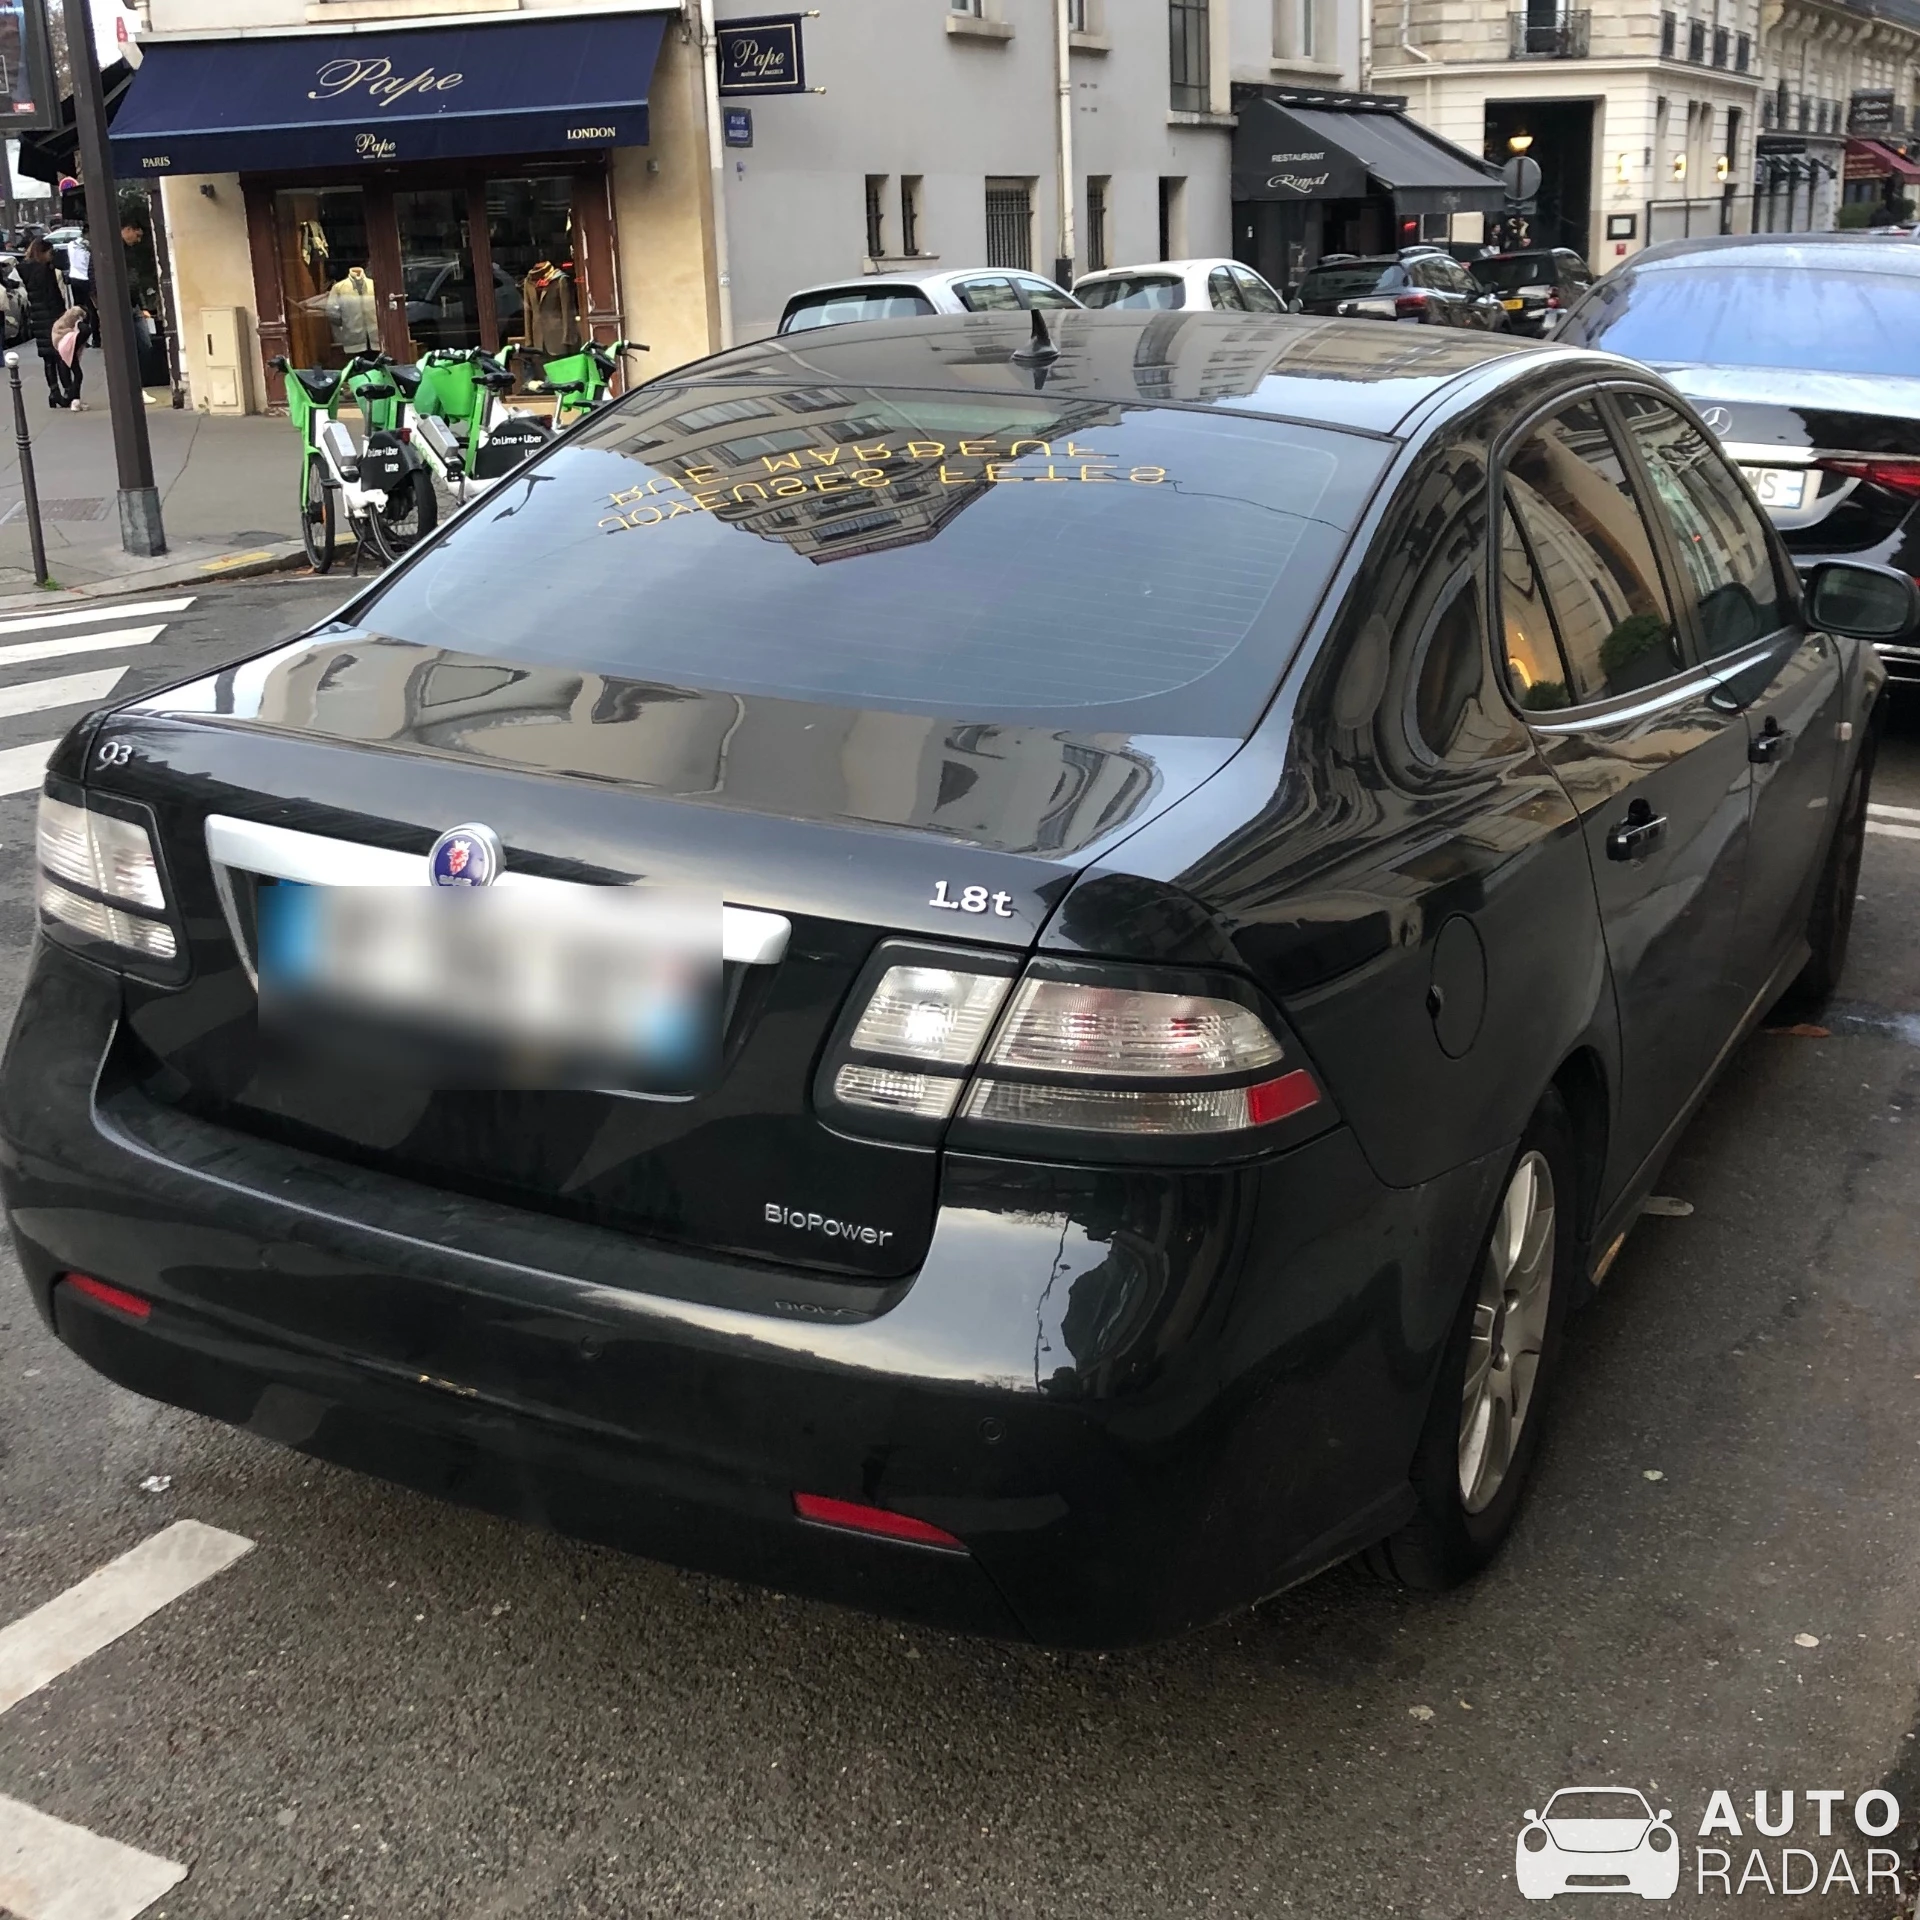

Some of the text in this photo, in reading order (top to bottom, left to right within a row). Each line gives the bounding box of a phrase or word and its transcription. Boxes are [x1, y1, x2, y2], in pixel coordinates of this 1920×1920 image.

[731, 39, 785, 76] Pape
[308, 56, 464, 107] Pape
[566, 126, 616, 140] LONDON
[355, 133, 397, 158] Pape
[142, 155, 171, 168] PARIS
[1271, 151, 1325, 163] RESTAURANT
[491, 436, 501, 446] On
[501, 435, 518, 445] Lime
[523, 434, 543, 444] Uber
[385, 446, 399, 456] Uber
[384, 463, 399, 472] Lime
[928, 880, 1012, 917] 1.8t
[764, 1202, 893, 1247] BioPower
